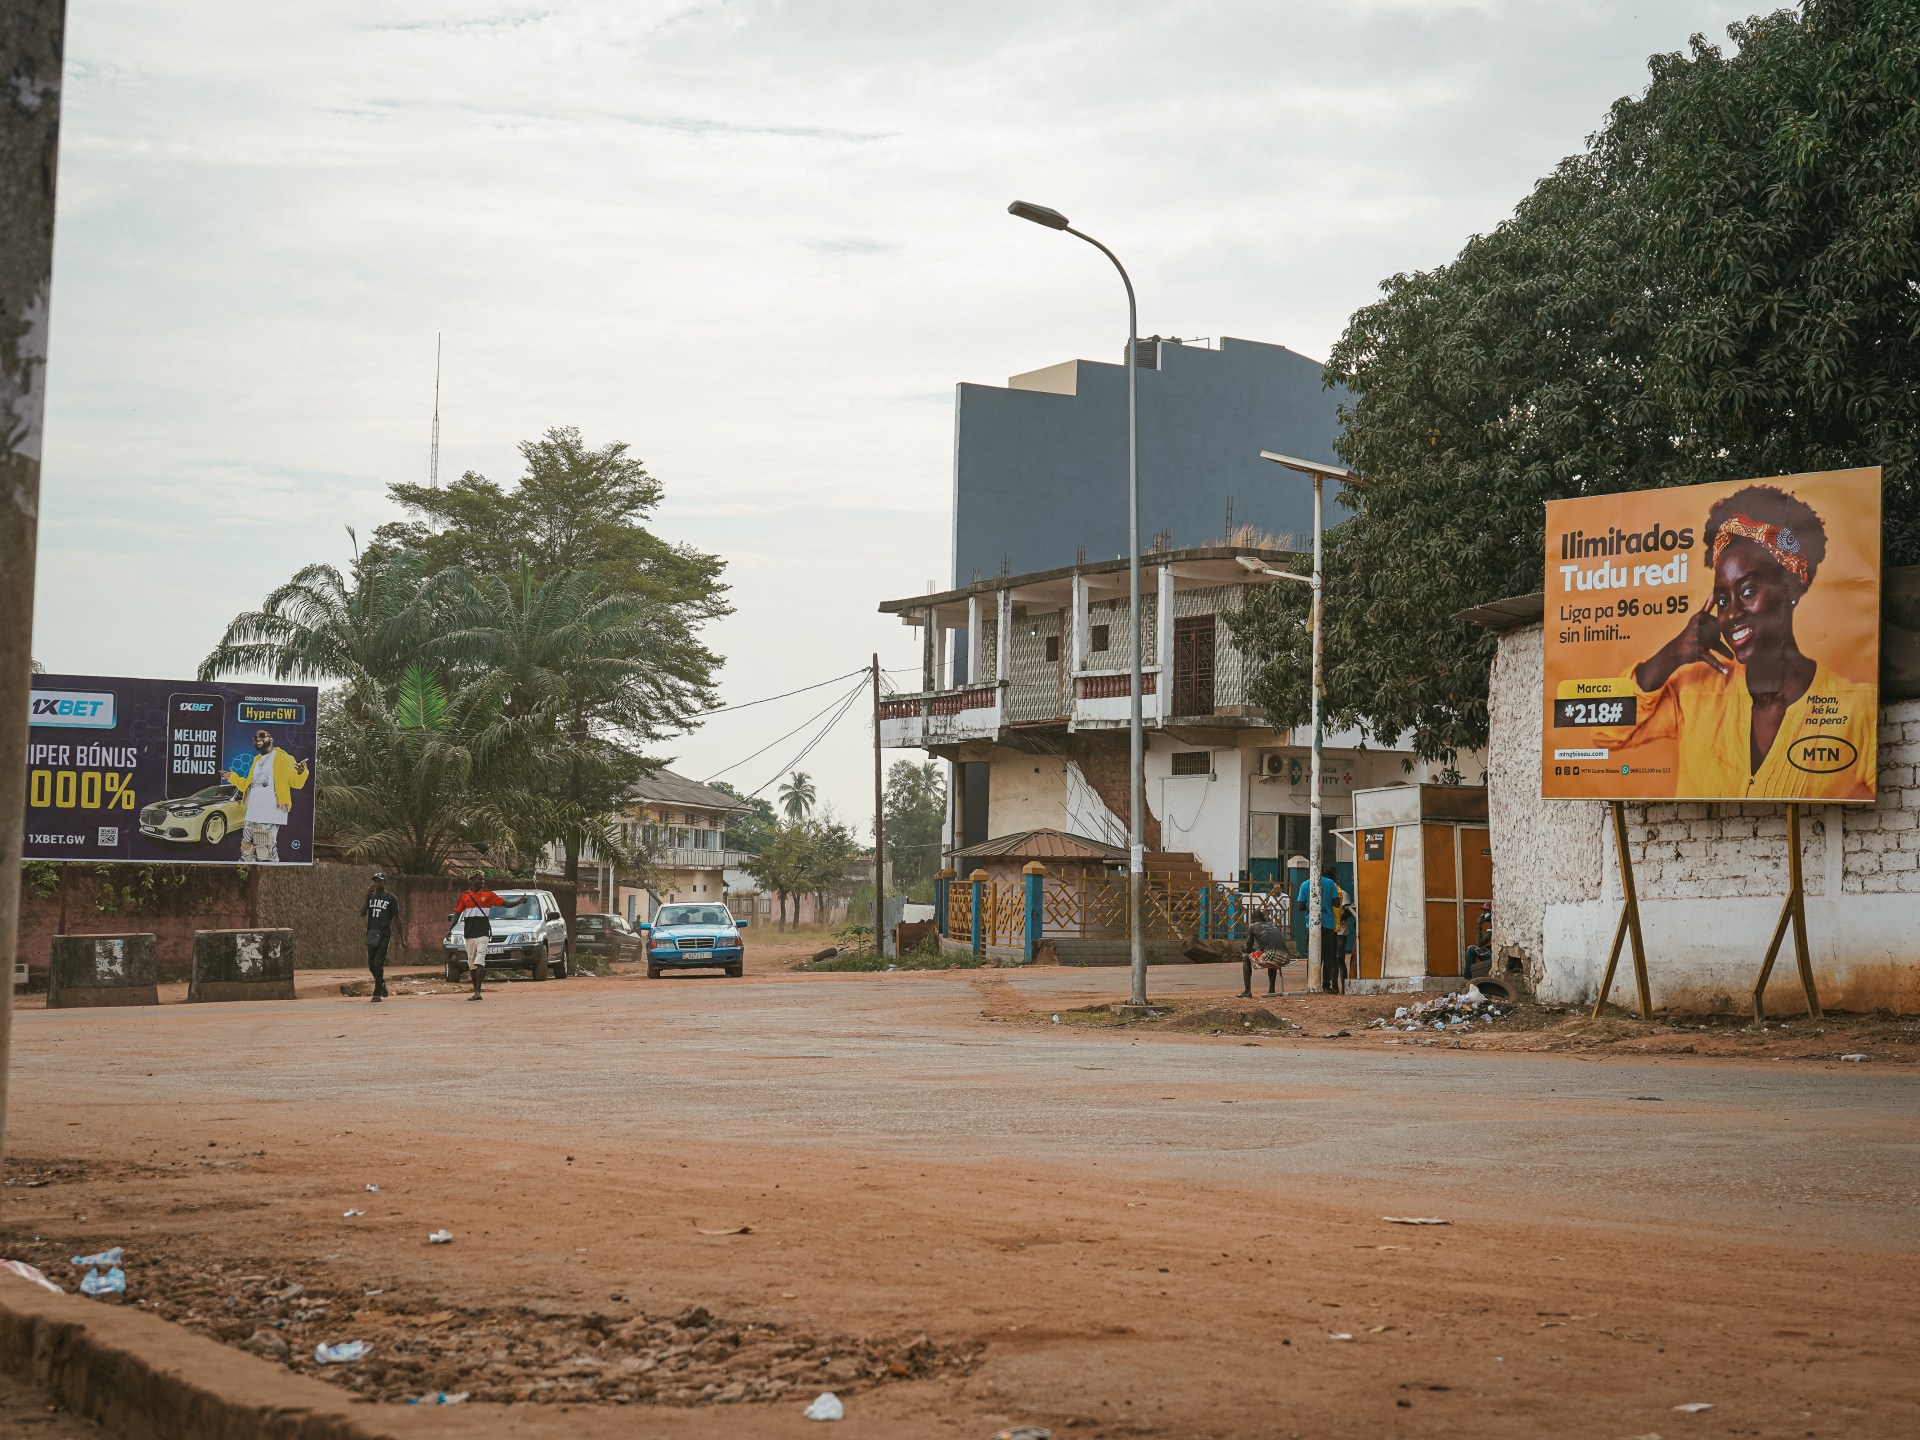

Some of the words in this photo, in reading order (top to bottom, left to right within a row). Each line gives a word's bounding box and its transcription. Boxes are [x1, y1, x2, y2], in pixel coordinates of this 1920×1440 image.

[1561, 523, 1694, 560] Ilimitados
[1559, 560, 1628, 592] Tudu
[1633, 553, 1688, 587] redi
[1560, 604, 1591, 624] Liga
[1595, 605, 1613, 623] pa
[1617, 598, 1639, 617] 96
[1642, 602, 1662, 616] ou
[1666, 595, 1689, 614] 95
[1559, 626, 1580, 644] sin
[1583, 623, 1631, 642] limiti...
[1577, 683, 1611, 693] Marca:
[32, 698, 104, 717] 1XBET
[179, 702, 214, 712] 1XBET
[1806, 695, 1839, 705] Mbom,
[246, 706, 296, 721] HyperGW1
[1811, 704, 1824, 715] ké
[1825, 705, 1839, 715] ku
[1805, 717, 1818, 725] na
[1819, 715, 1848, 727] pera?
[174, 729, 217, 743] MELHOR
[76, 742, 138, 768] BÓNUS
[173, 743, 190, 757] DO
[193, 745, 217, 758] QUE
[1803, 747, 1840, 762] MTN
[172, 757, 216, 775] BÓNUS
[28, 833, 86, 845] 1XBET.GW
[369, 899, 390, 909] LIKE
[372, 909, 381, 917] IT
